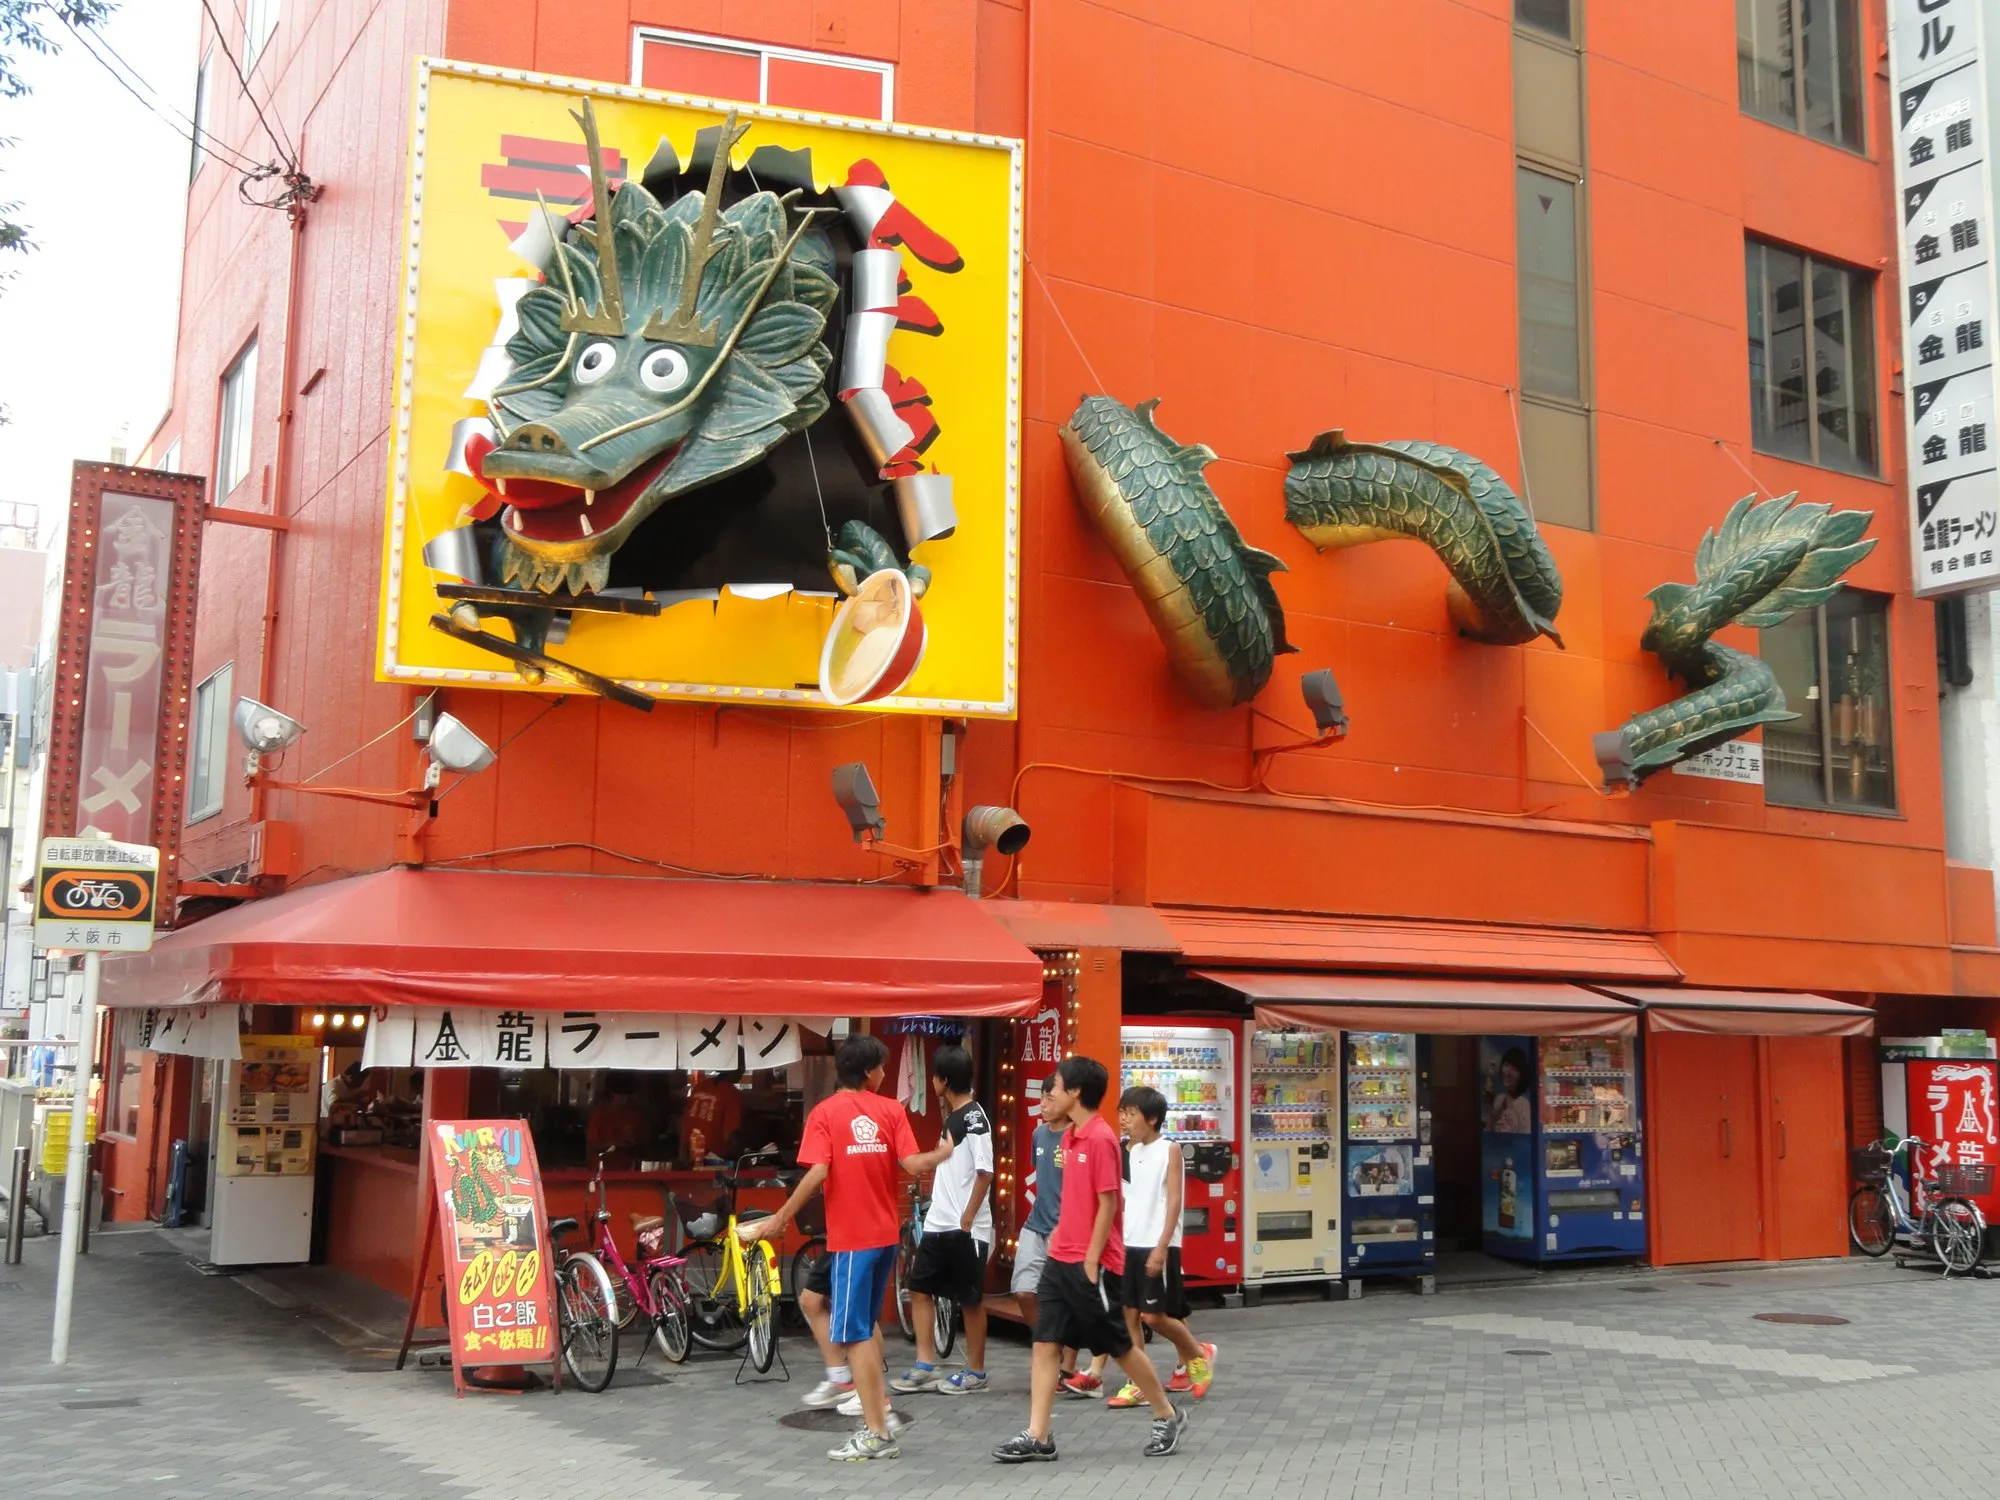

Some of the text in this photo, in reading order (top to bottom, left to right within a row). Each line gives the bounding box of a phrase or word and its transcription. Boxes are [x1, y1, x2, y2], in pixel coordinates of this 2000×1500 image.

[1906, 96, 1917, 111] 5
[1909, 118, 1973, 168] 金龍
[1909, 193, 1922, 207] 4
[1914, 218, 1980, 265] 金龍
[1915, 291, 1927, 306] 3
[1918, 319, 1983, 365] 金龍
[1919, 392, 1930, 406] 2
[1922, 422, 1987, 465] 金龍
[1923, 492, 1933, 507] 1
[1922, 510, 1997, 551] 金龍ラーメン
[78, 504, 167, 838] 金龍ラーメ
[47, 847, 153, 864] 自転車放置禁止区域
[64, 930, 123, 945] 大阪市
[425, 1010, 790, 1063] 金龍ラーメン
[846, 1143, 888, 1155] FANATICOS
[473, 1300, 538, 1329] 白ご飯
